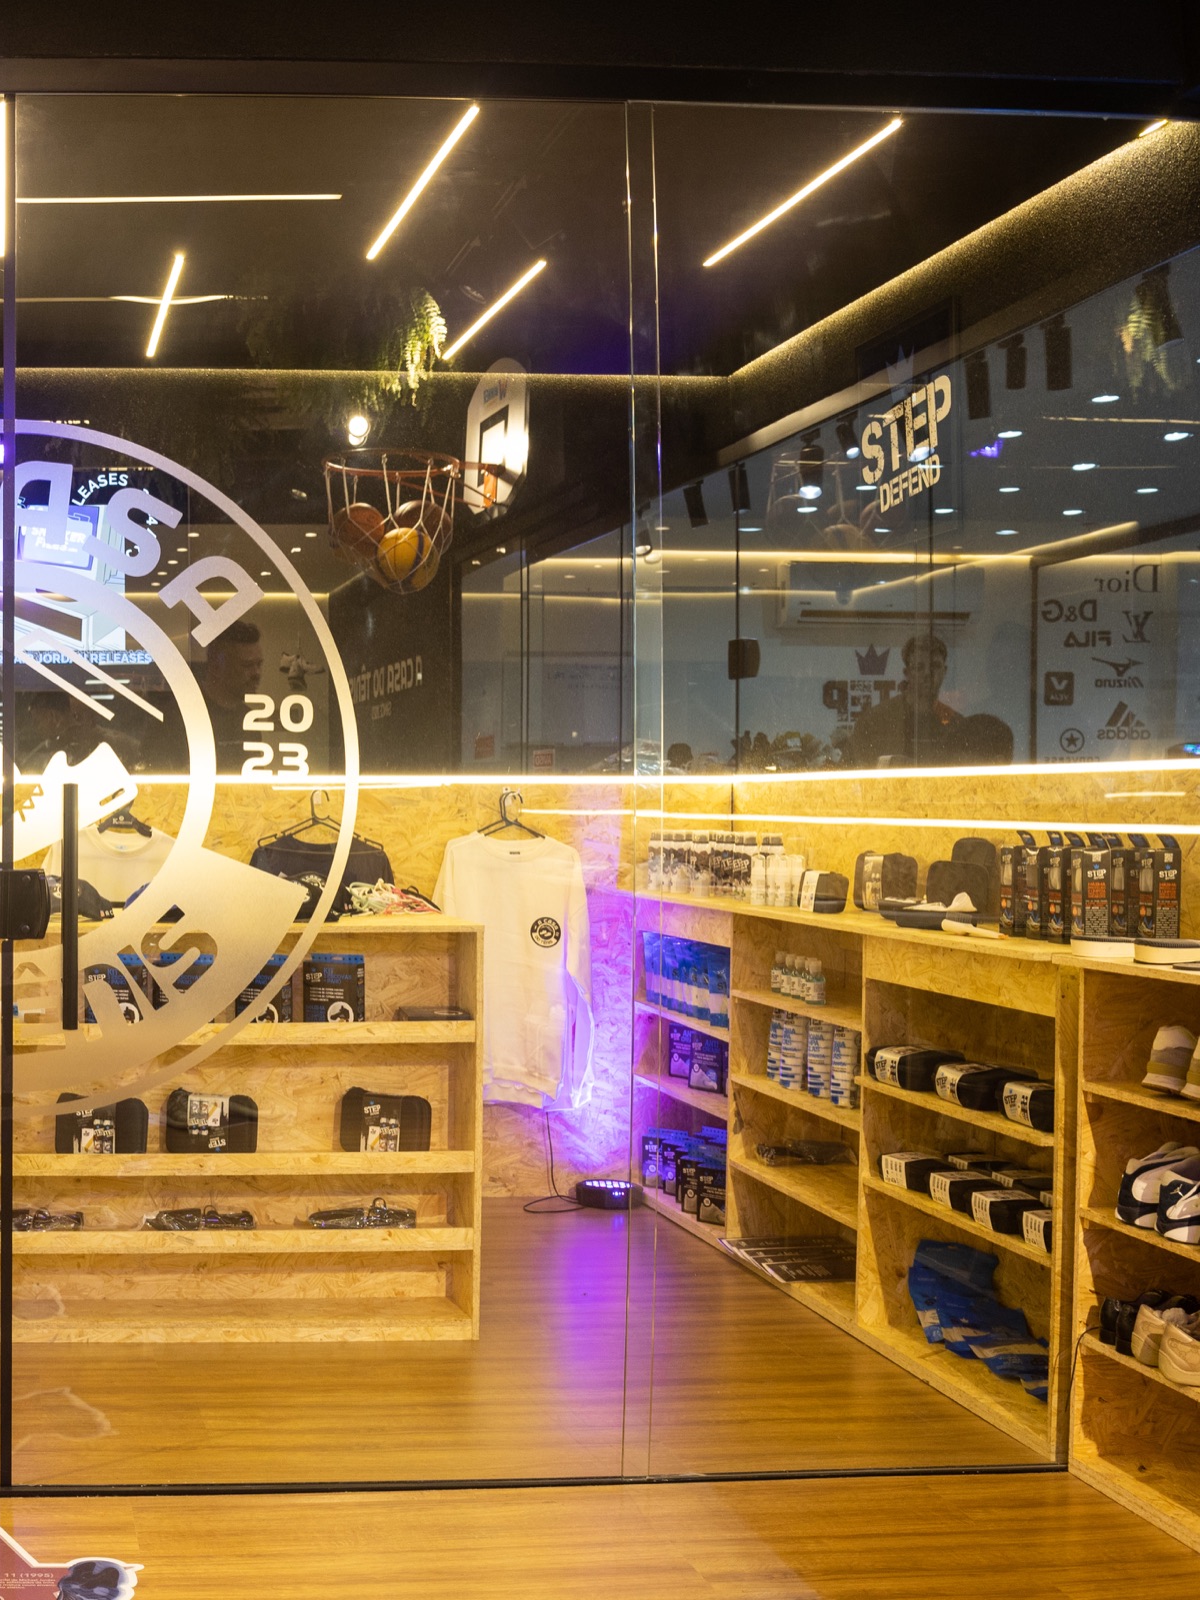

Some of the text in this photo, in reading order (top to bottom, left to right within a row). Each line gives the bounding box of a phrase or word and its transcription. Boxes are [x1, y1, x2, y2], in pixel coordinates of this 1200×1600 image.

[861, 375, 951, 485] STEP
[879, 454, 941, 514] DEFEND
[89, 653, 153, 664] RELEASES
[242, 694, 314, 733] 20
[241, 741, 310, 778] 23
[305, 972, 323, 980] STEP
[363, 1105, 381, 1114] STEP
